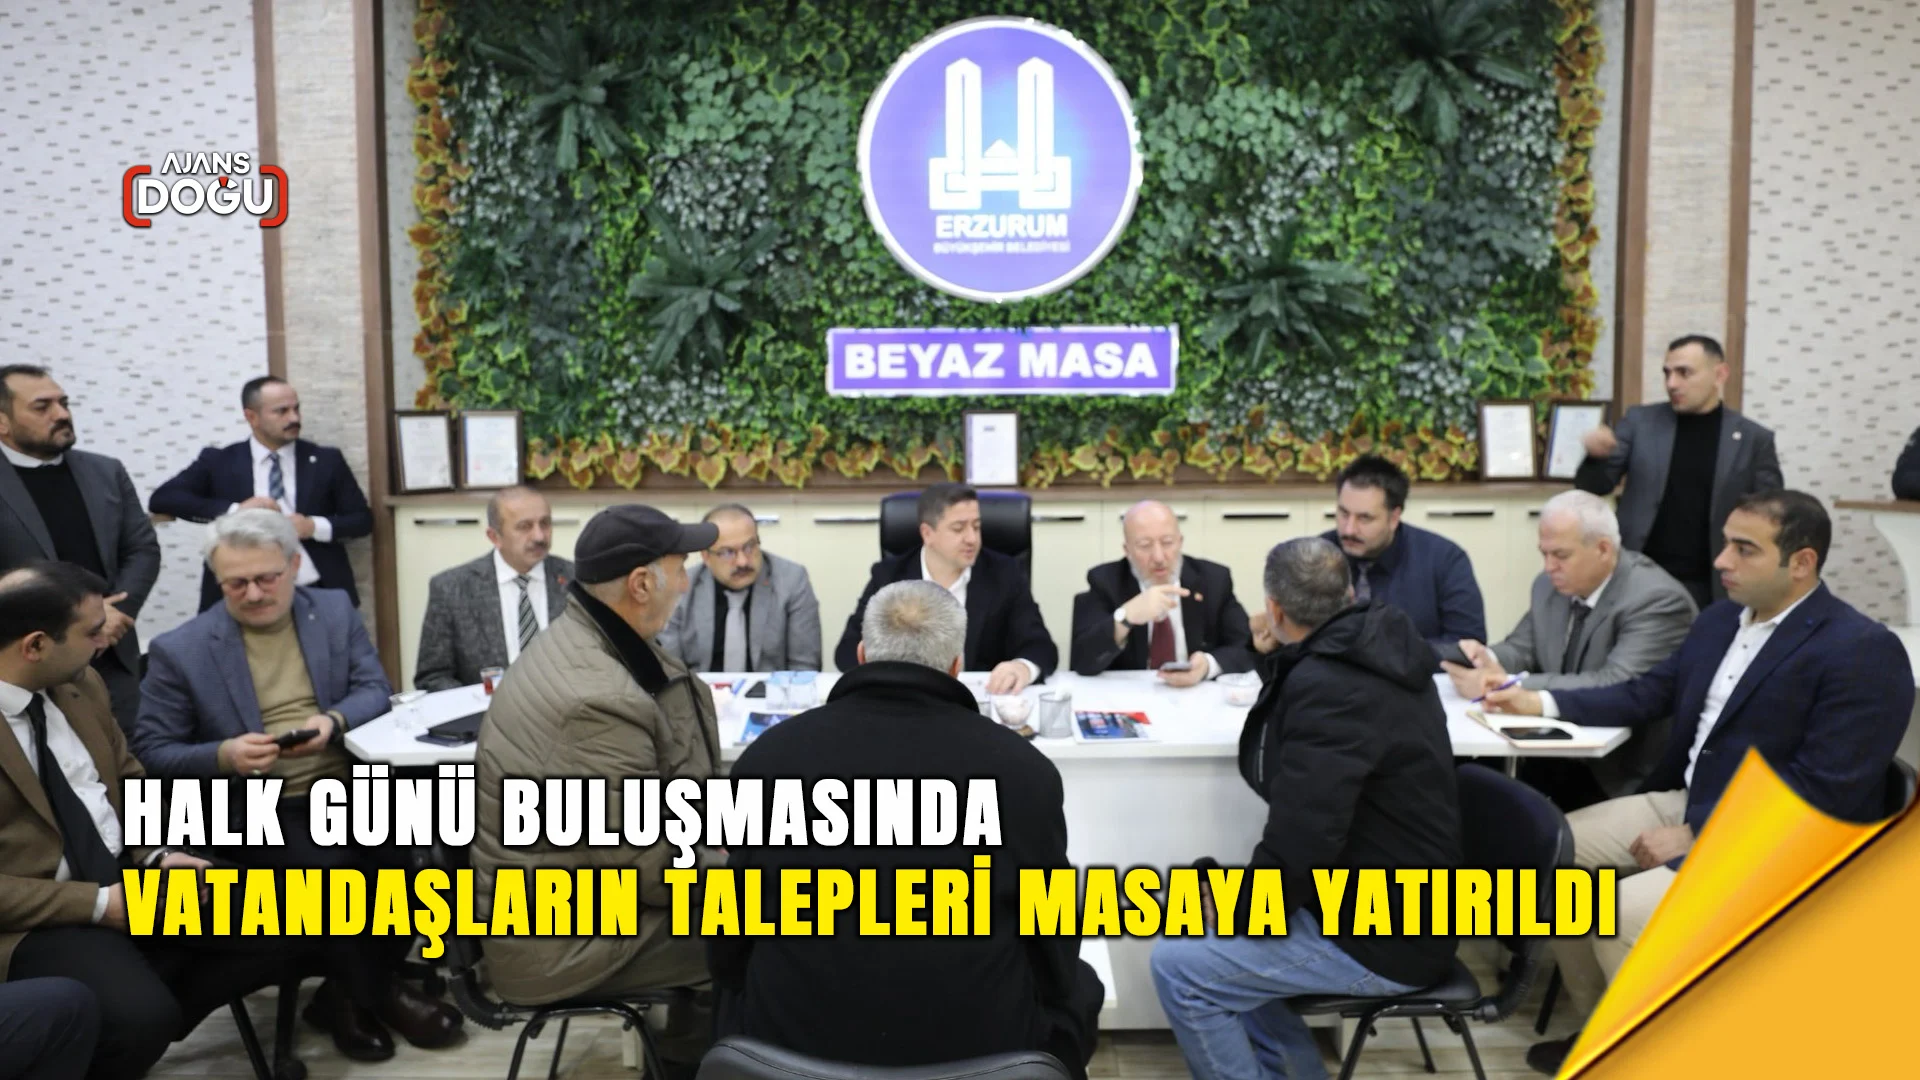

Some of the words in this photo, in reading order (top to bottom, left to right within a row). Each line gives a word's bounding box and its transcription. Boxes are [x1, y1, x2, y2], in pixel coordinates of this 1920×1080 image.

[936, 214, 1068, 239] ERZURUM
[845, 343, 1005, 379] BEYAZ
[1019, 342, 1158, 378] MASA
